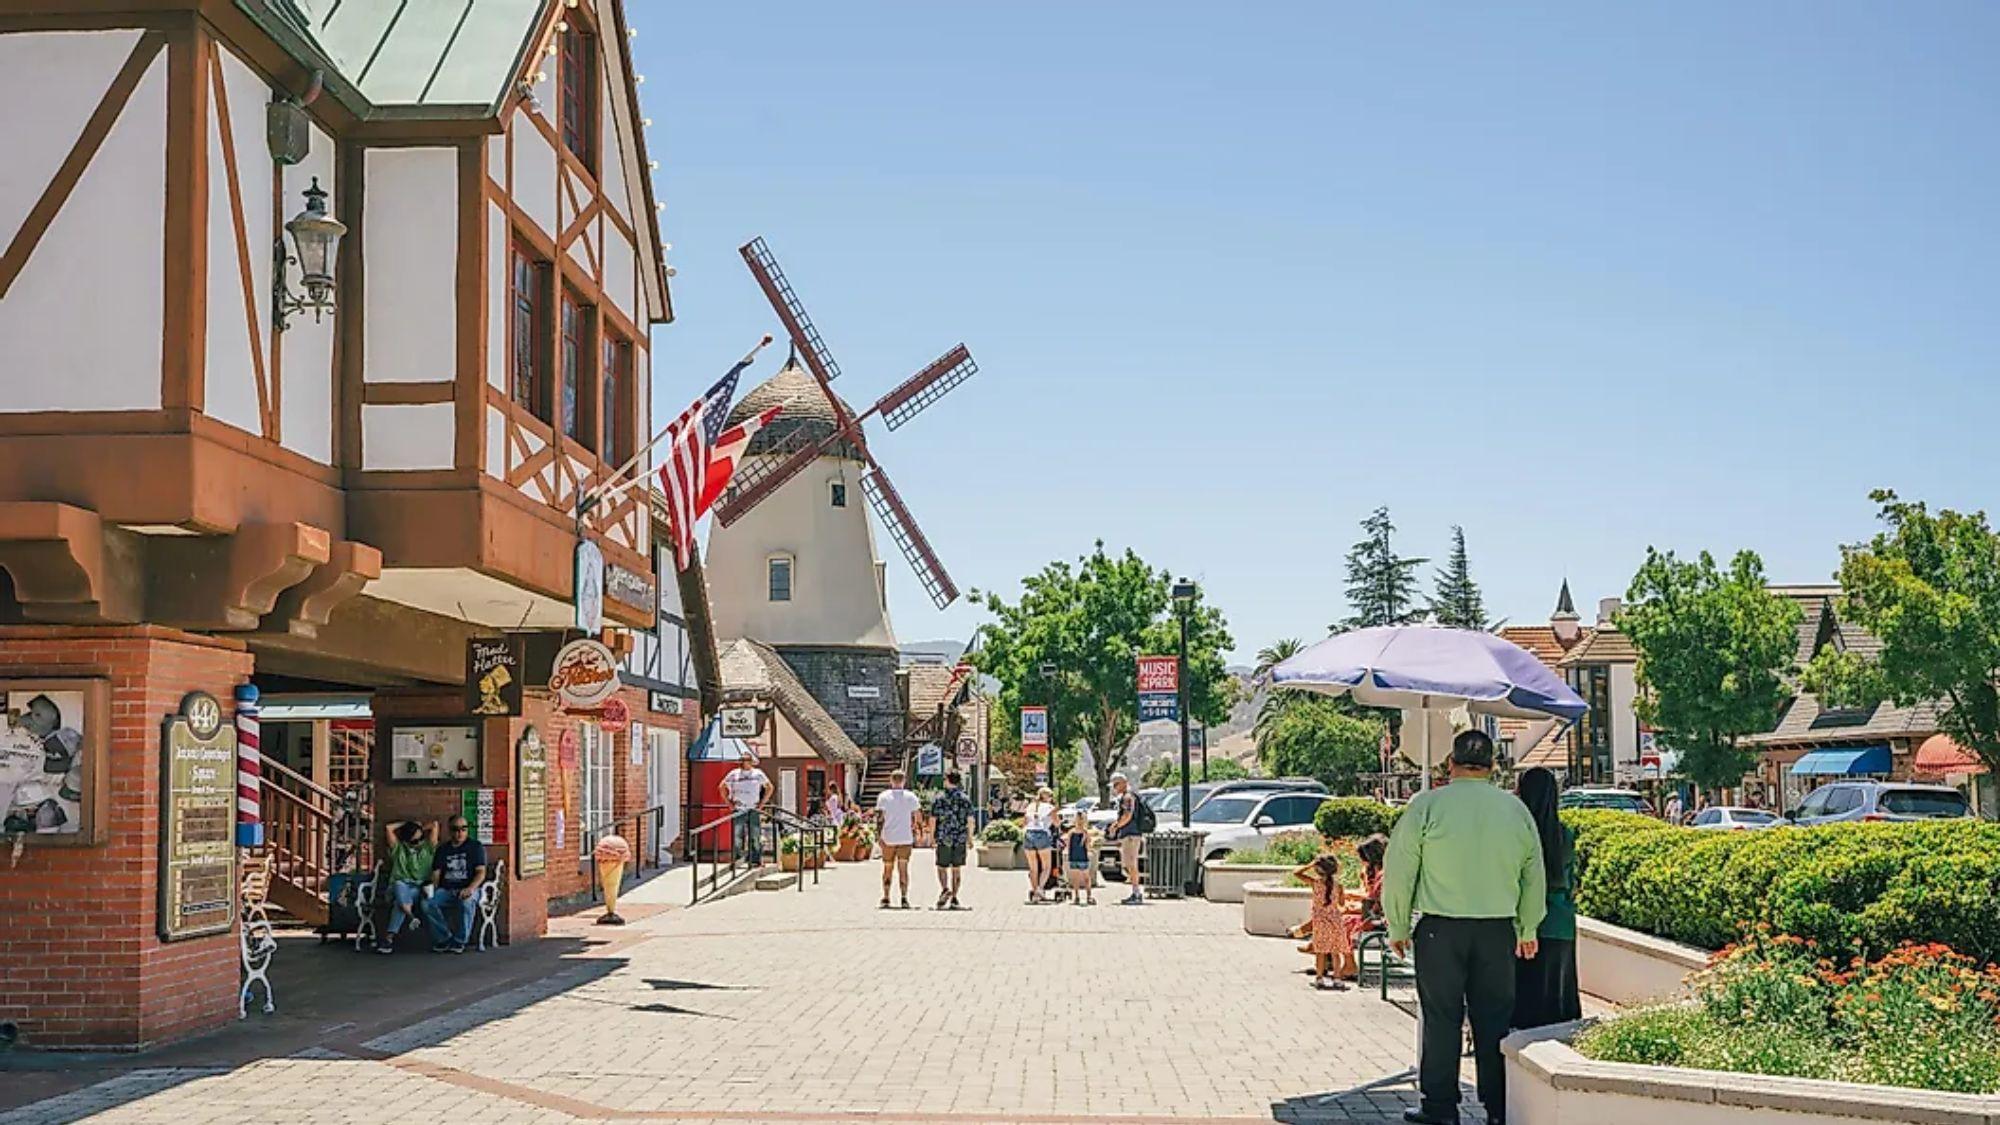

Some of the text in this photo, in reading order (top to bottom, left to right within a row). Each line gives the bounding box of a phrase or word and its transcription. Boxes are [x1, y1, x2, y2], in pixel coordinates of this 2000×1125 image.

[475, 643, 509, 660] Mad
[473, 655, 516, 673] Hatter
[1139, 662, 1176, 675] MUSIC
[1150, 676, 1177, 689] PARK
[188, 699, 219, 728] 446
